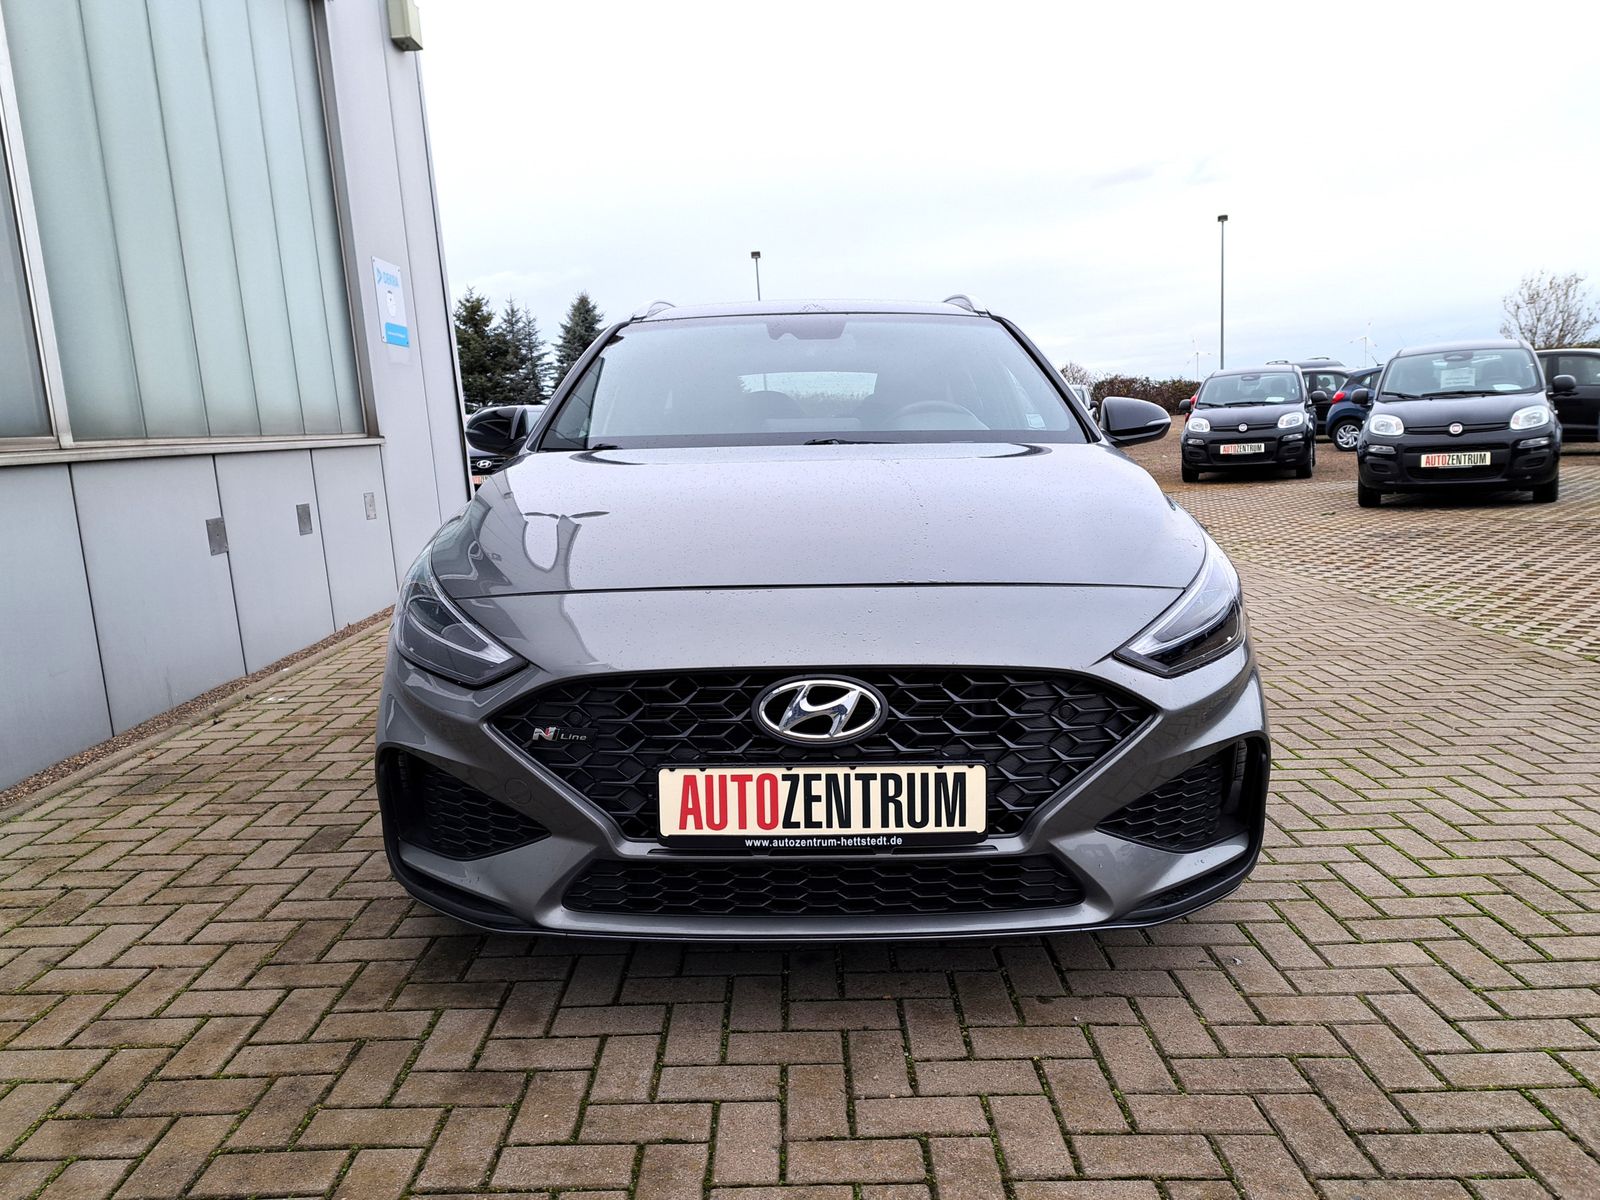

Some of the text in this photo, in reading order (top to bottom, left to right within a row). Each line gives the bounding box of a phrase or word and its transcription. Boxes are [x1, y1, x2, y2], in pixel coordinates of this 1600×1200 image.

[1222, 443, 1262, 453] AUTOZENTRUM
[1425, 453, 1487, 466] AUTOZENTRUM
[560, 732, 587, 741] Line
[678, 771, 967, 831] AUTOZENTRUM
[744, 835, 903, 848] www.autozentrum-hettstedt.de
